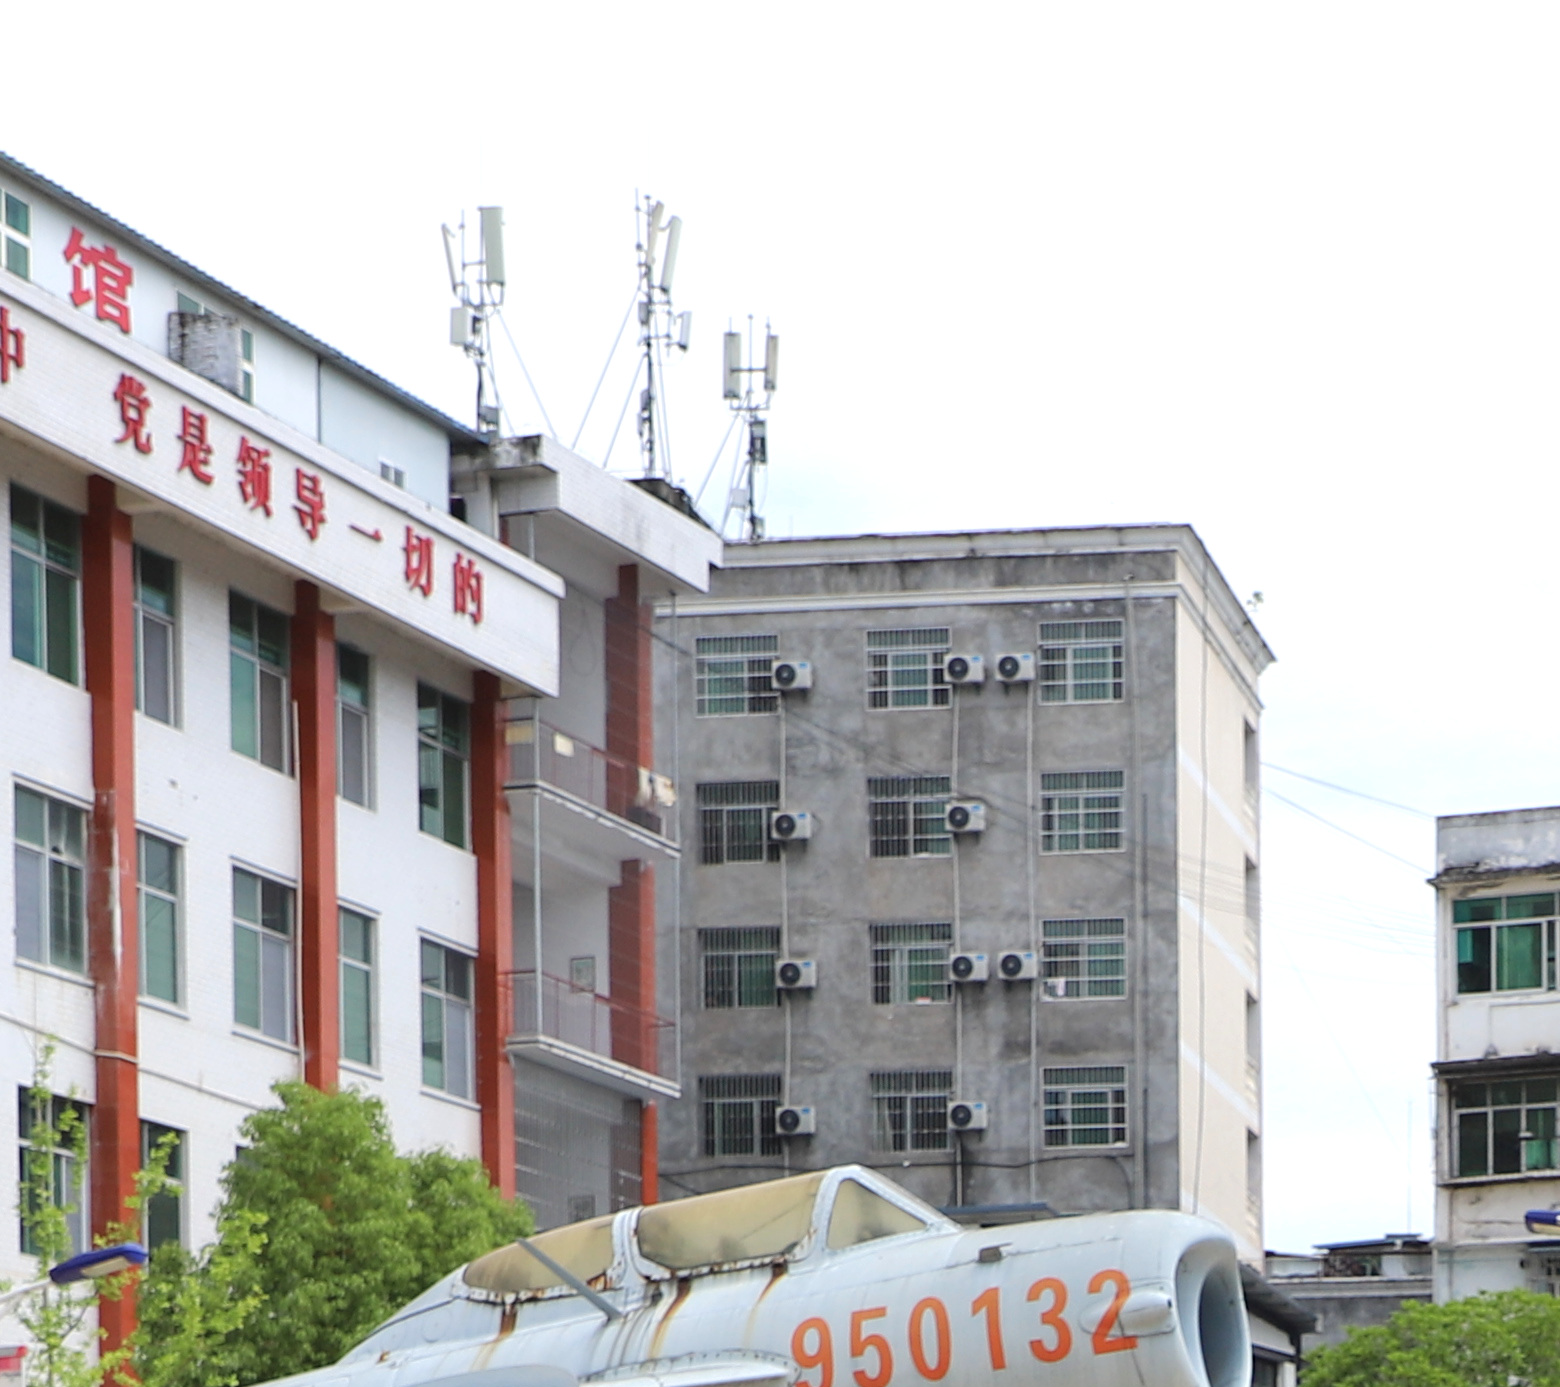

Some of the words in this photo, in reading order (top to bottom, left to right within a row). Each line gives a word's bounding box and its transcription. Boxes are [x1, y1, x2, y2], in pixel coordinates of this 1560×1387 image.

[113, 372, 484, 626] 党是领导一切的
